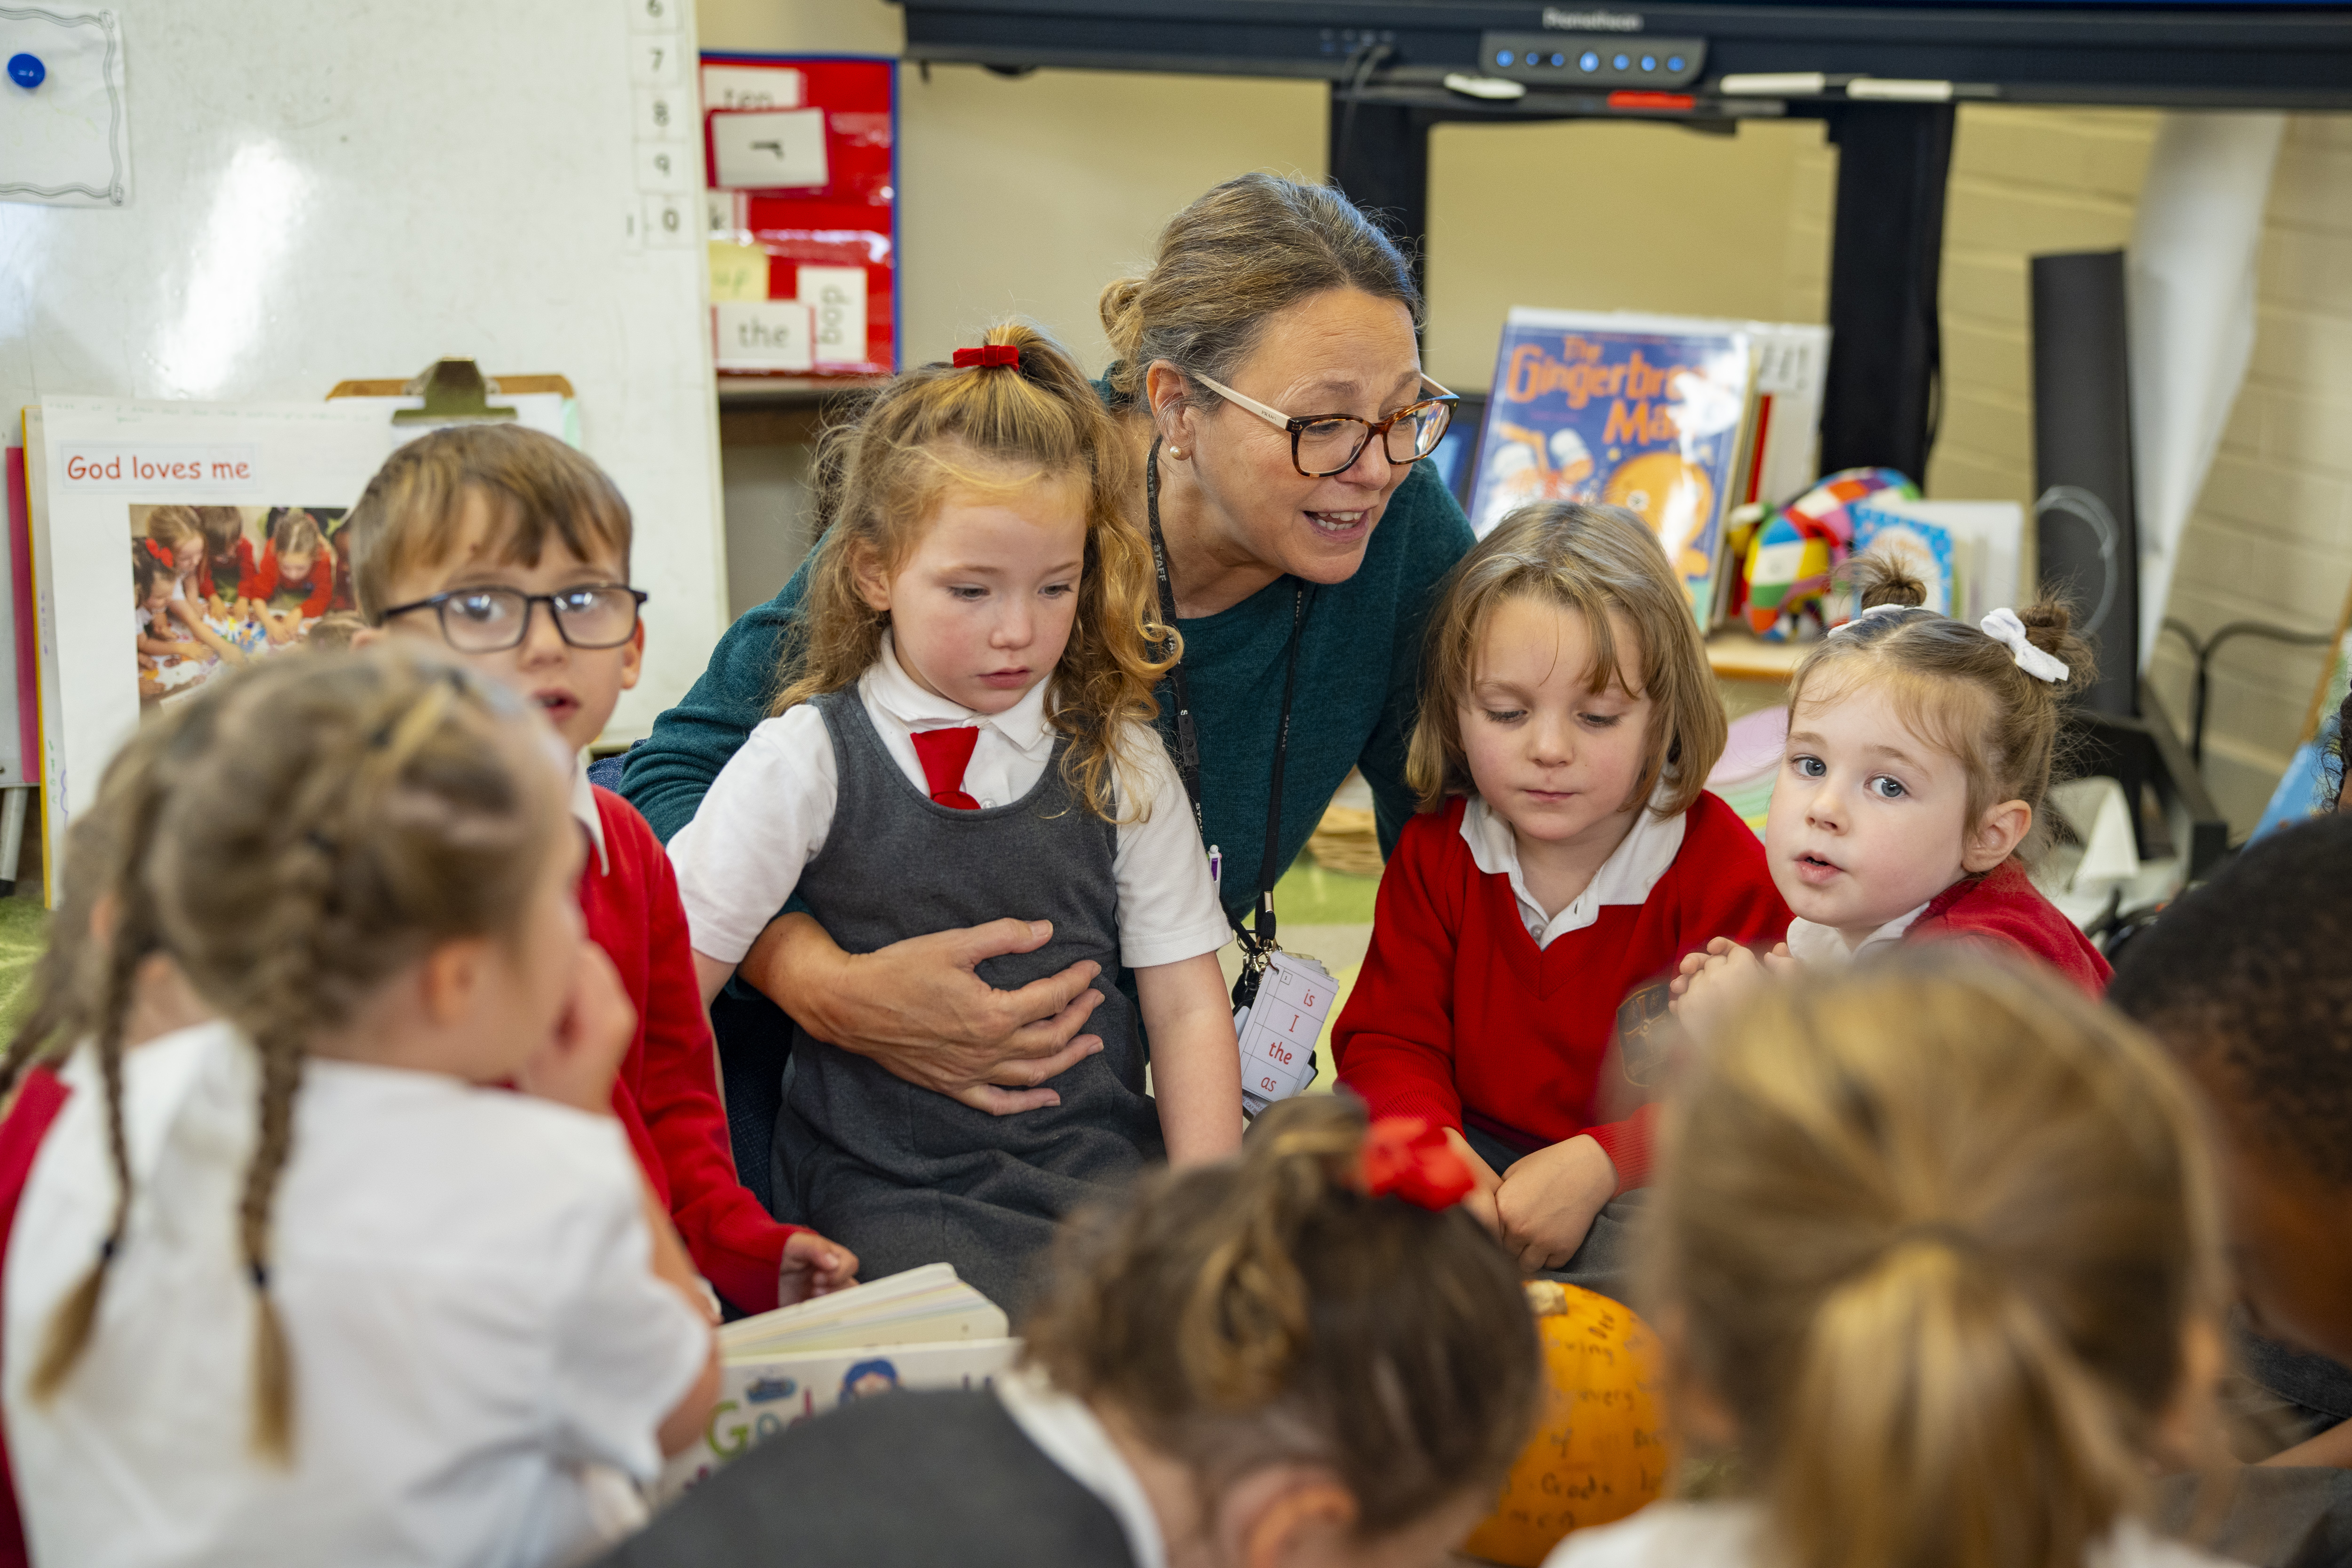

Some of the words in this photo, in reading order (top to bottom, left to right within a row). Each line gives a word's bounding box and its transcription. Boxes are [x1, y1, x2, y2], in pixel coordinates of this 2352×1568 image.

[649, 47, 664, 71] 7
[653, 100, 670, 127] 8
[653, 153, 671, 178] 9
[738, 315, 789, 348] the
[1507, 343, 1707, 410] Gingerbre
[1262, 410, 1276, 421] PRADA
[1602, 398, 1680, 446] Ma
[68, 455, 120, 479] God
[133, 455, 201, 479] loves
[212, 462, 250, 479] me
[1154, 544, 1166, 581] STAFF
[1303, 989, 1315, 1007] is
[1289, 1015, 1299, 1032] I
[1269, 1042, 1292, 1065] the
[1261, 1077, 1277, 1092] as
[1247, 1094, 1263, 1109] PRIMARY
